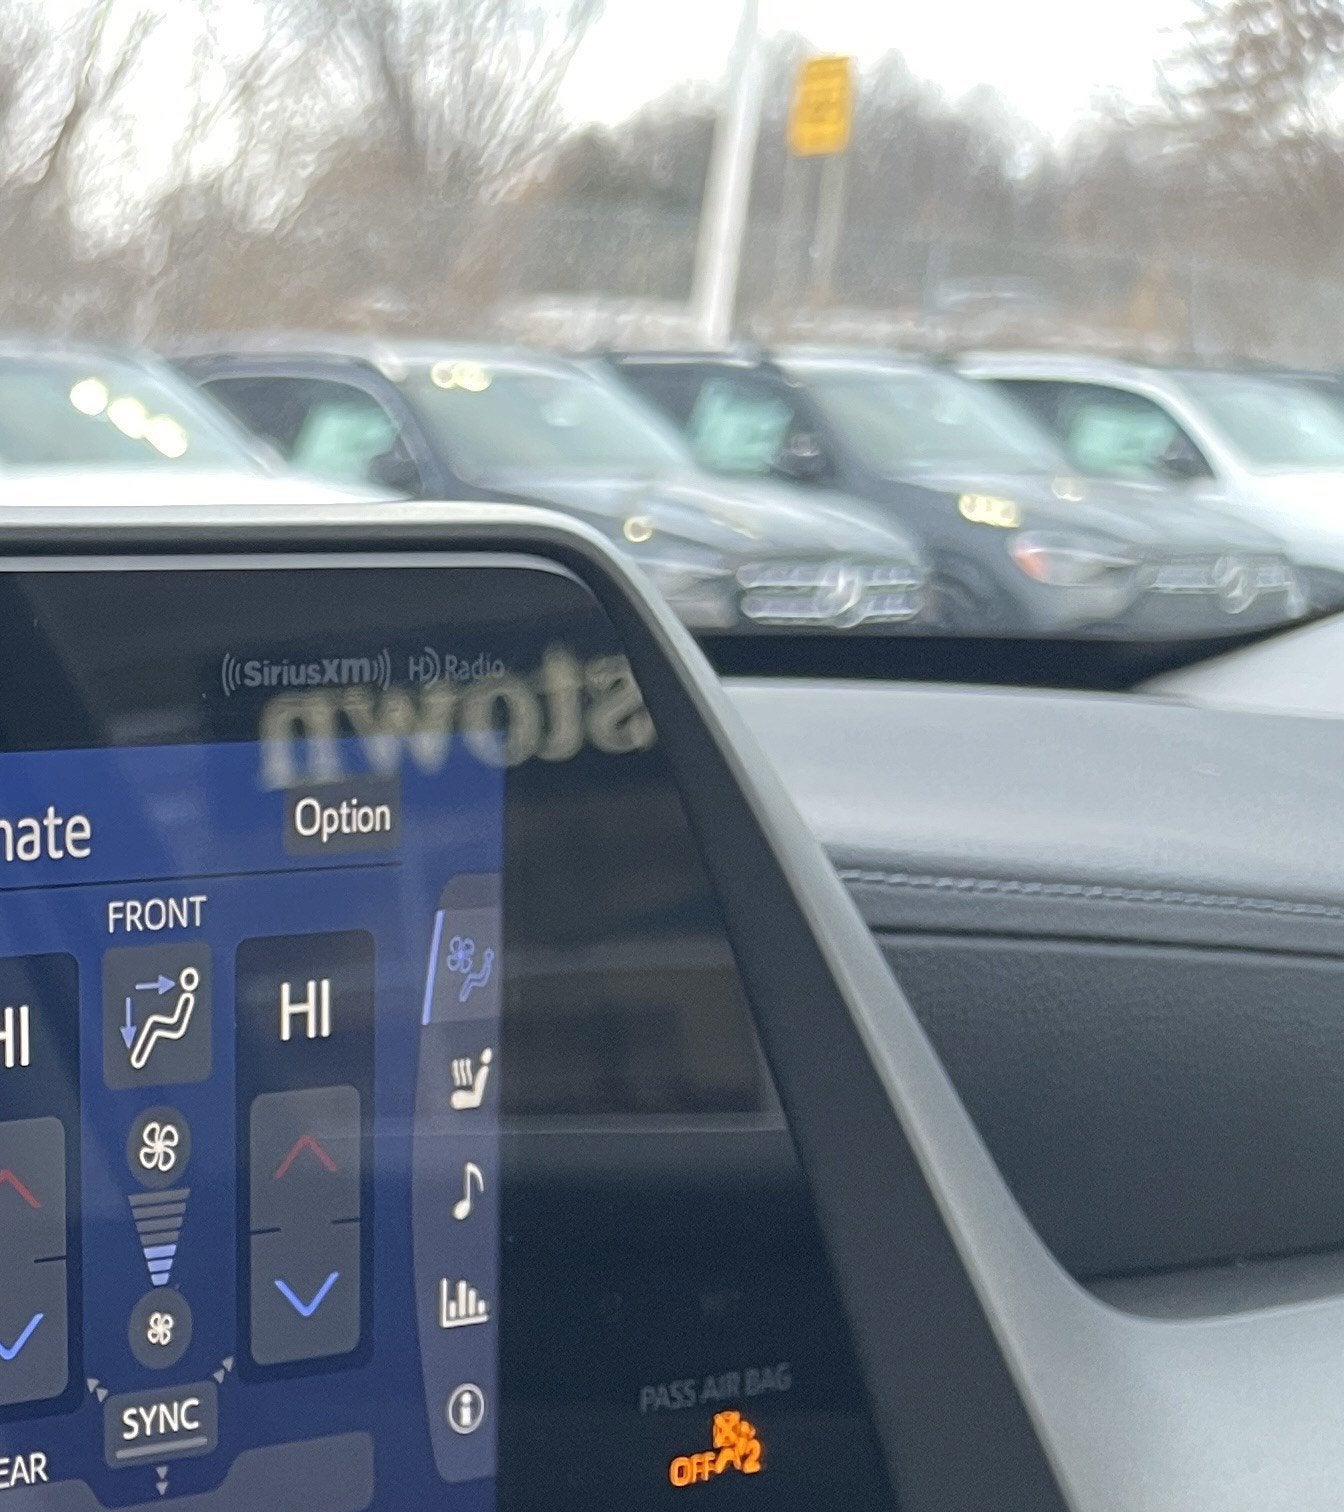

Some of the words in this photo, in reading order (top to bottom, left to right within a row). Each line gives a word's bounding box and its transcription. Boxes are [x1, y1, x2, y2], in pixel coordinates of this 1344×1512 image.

[445, 652, 506, 682] Radio
[292, 796, 392, 844] Option
[107, 895, 208, 934] FRONT
[279, 978, 333, 1042] HI
[122, 1398, 201, 1439] SYNC
[669, 1451, 716, 1487] OFF
